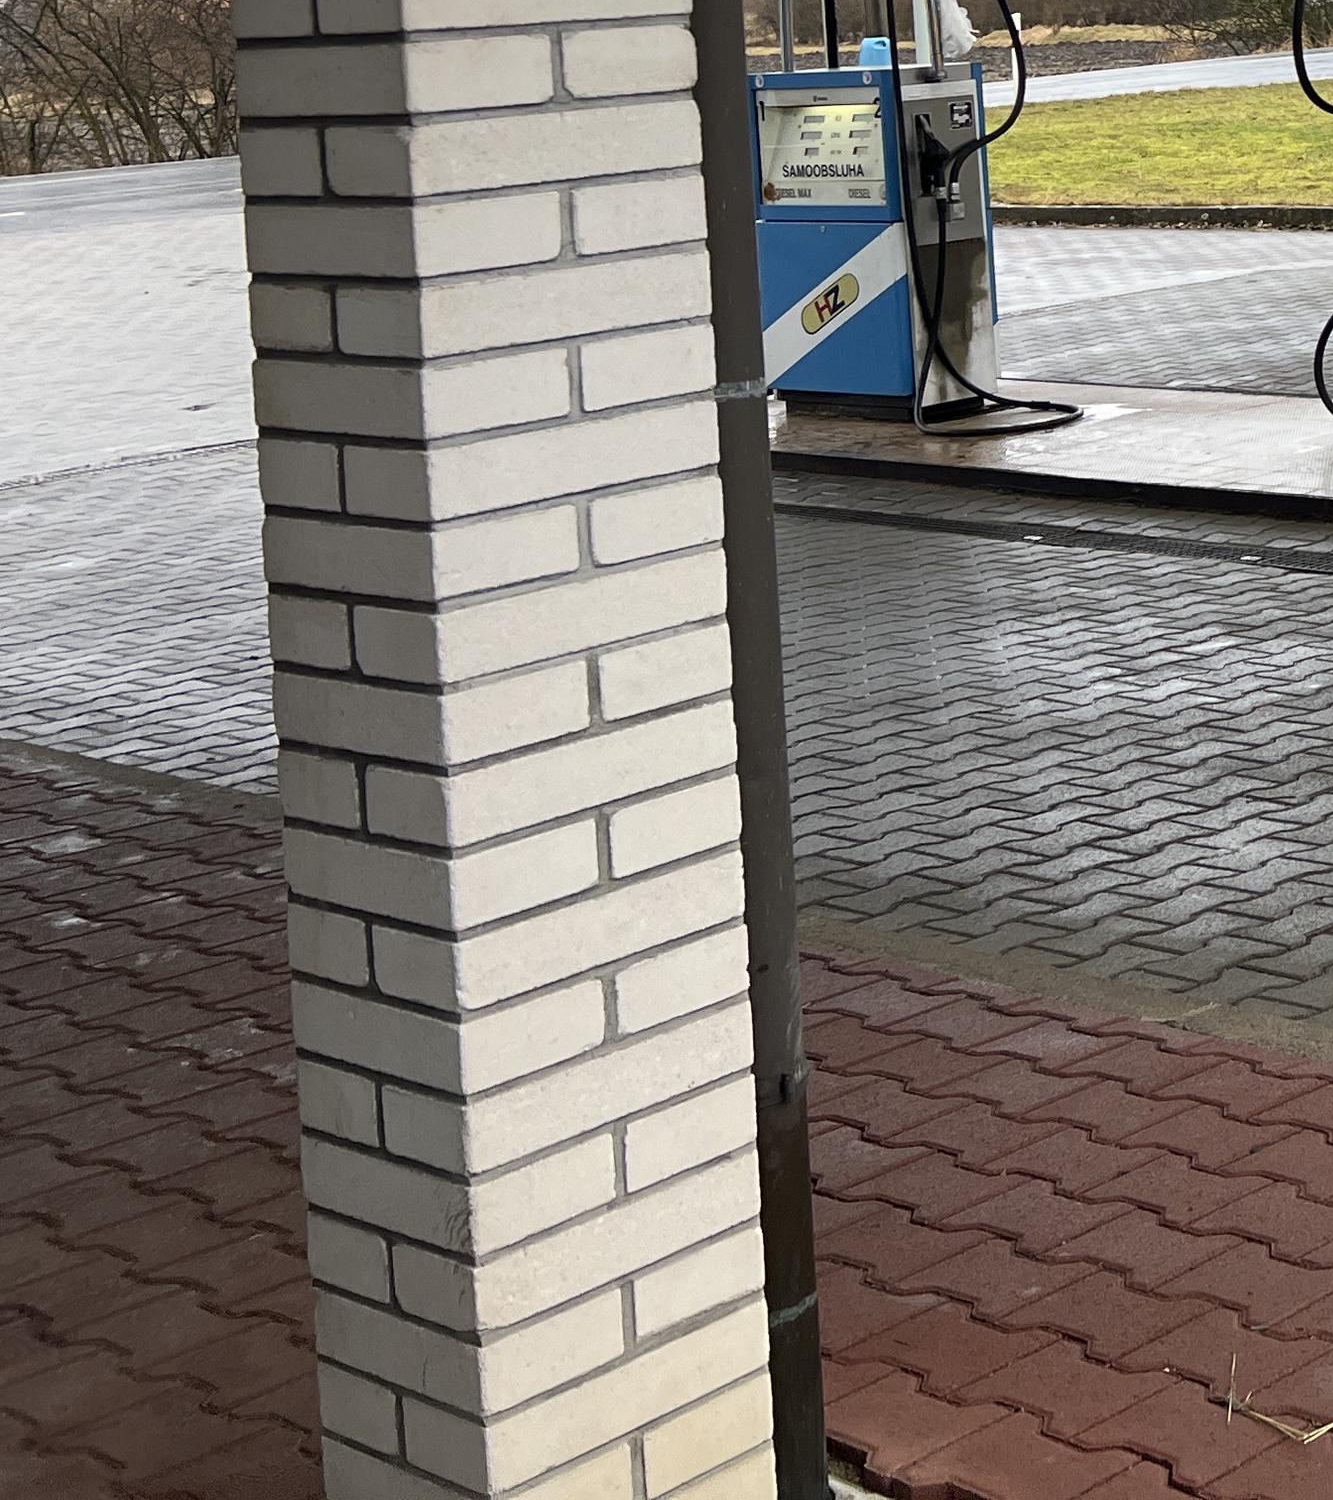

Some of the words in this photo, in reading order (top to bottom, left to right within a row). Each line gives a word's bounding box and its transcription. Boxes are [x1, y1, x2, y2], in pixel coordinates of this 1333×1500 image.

[759, 100, 766, 122] 1
[872, 96, 882, 118] 2
[782, 163, 865, 179] SAMOOBSLUHA
[848, 188, 872, 199] DIESEL
[814, 283, 846, 324] HZ
